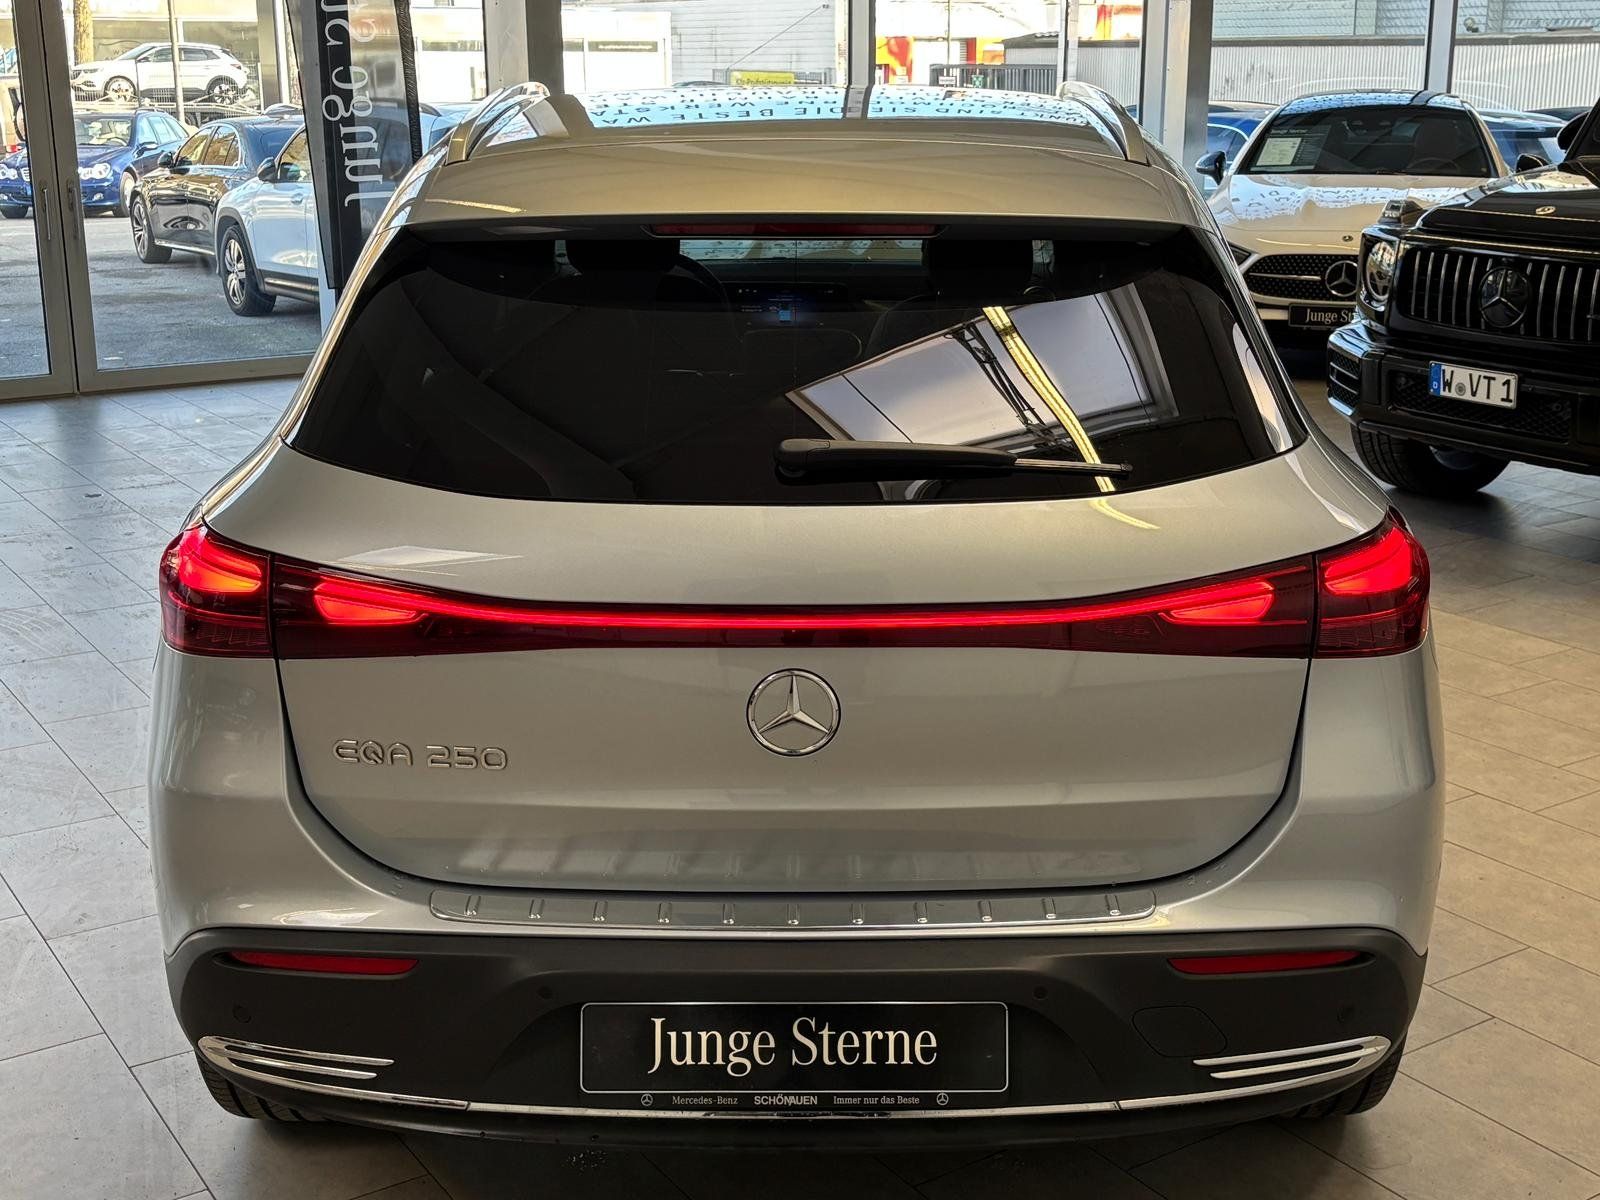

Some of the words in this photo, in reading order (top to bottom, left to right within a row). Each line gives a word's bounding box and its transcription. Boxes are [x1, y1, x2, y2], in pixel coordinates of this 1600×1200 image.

[1305, 308, 1338, 325] Junge
[1469, 373, 1497, 400] VT
[332, 739, 414, 767] EQA
[426, 745, 508, 771] 250
[647, 1017, 776, 1077] Junge
[791, 1016, 938, 1066] Sterne
[672, 1095, 738, 1105] Mercedes-Benz
[833, 1095, 860, 1105] Immer
[863, 1096, 879, 1105] nur
[880, 1095, 895, 1105] das
[897, 1095, 920, 1105] Beste
